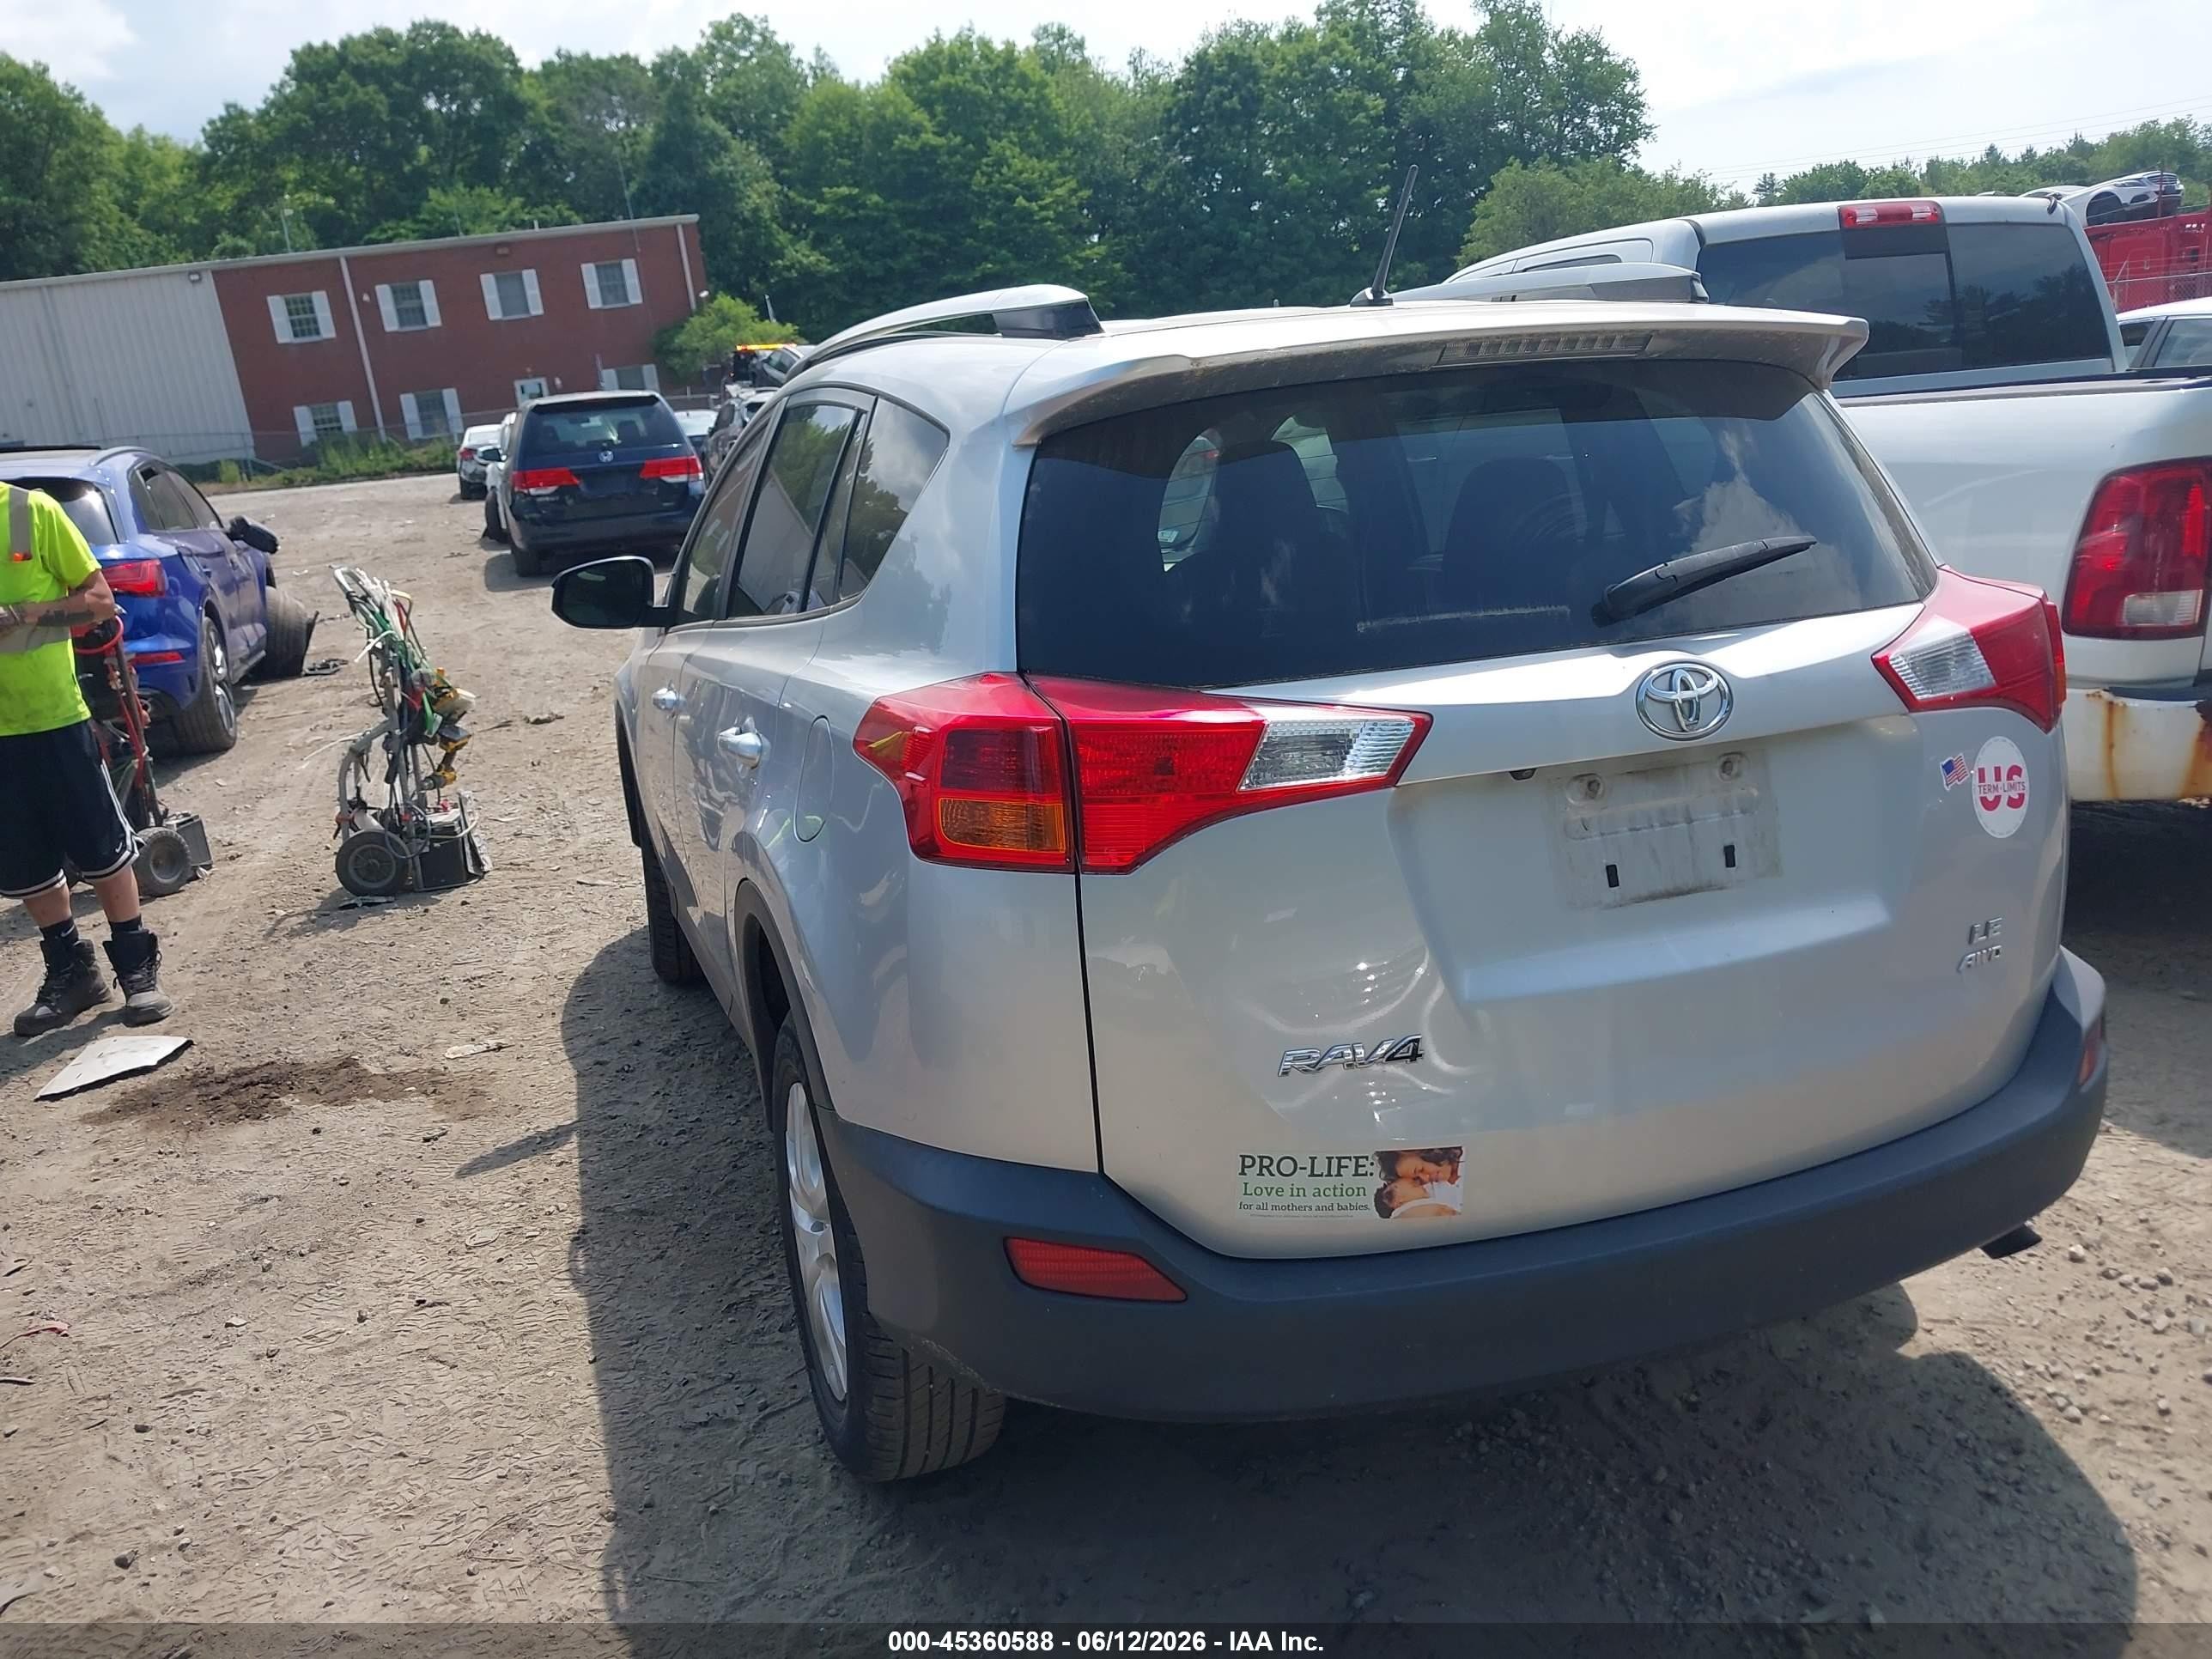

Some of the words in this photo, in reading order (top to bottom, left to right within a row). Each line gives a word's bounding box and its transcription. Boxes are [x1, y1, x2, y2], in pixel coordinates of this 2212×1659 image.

[1978, 764, 2026, 811] US
[1967, 917, 2002, 945] LE
[1278, 1034, 1425, 1077] RAV4
[1238, 1154, 1374, 1177] PRO-LIFE:
[1243, 1182, 1285, 1197] Love
[1289, 1183, 1307, 1198] in
[1312, 1183, 1367, 1198] action
[1238, 1201, 1253, 1211] for
[1255, 1201, 1269, 1211] all
[1270, 1202, 1313, 1212] mothers
[1315, 1202, 1334, 1212] and
[1337, 1201, 1370, 1212] babies.
